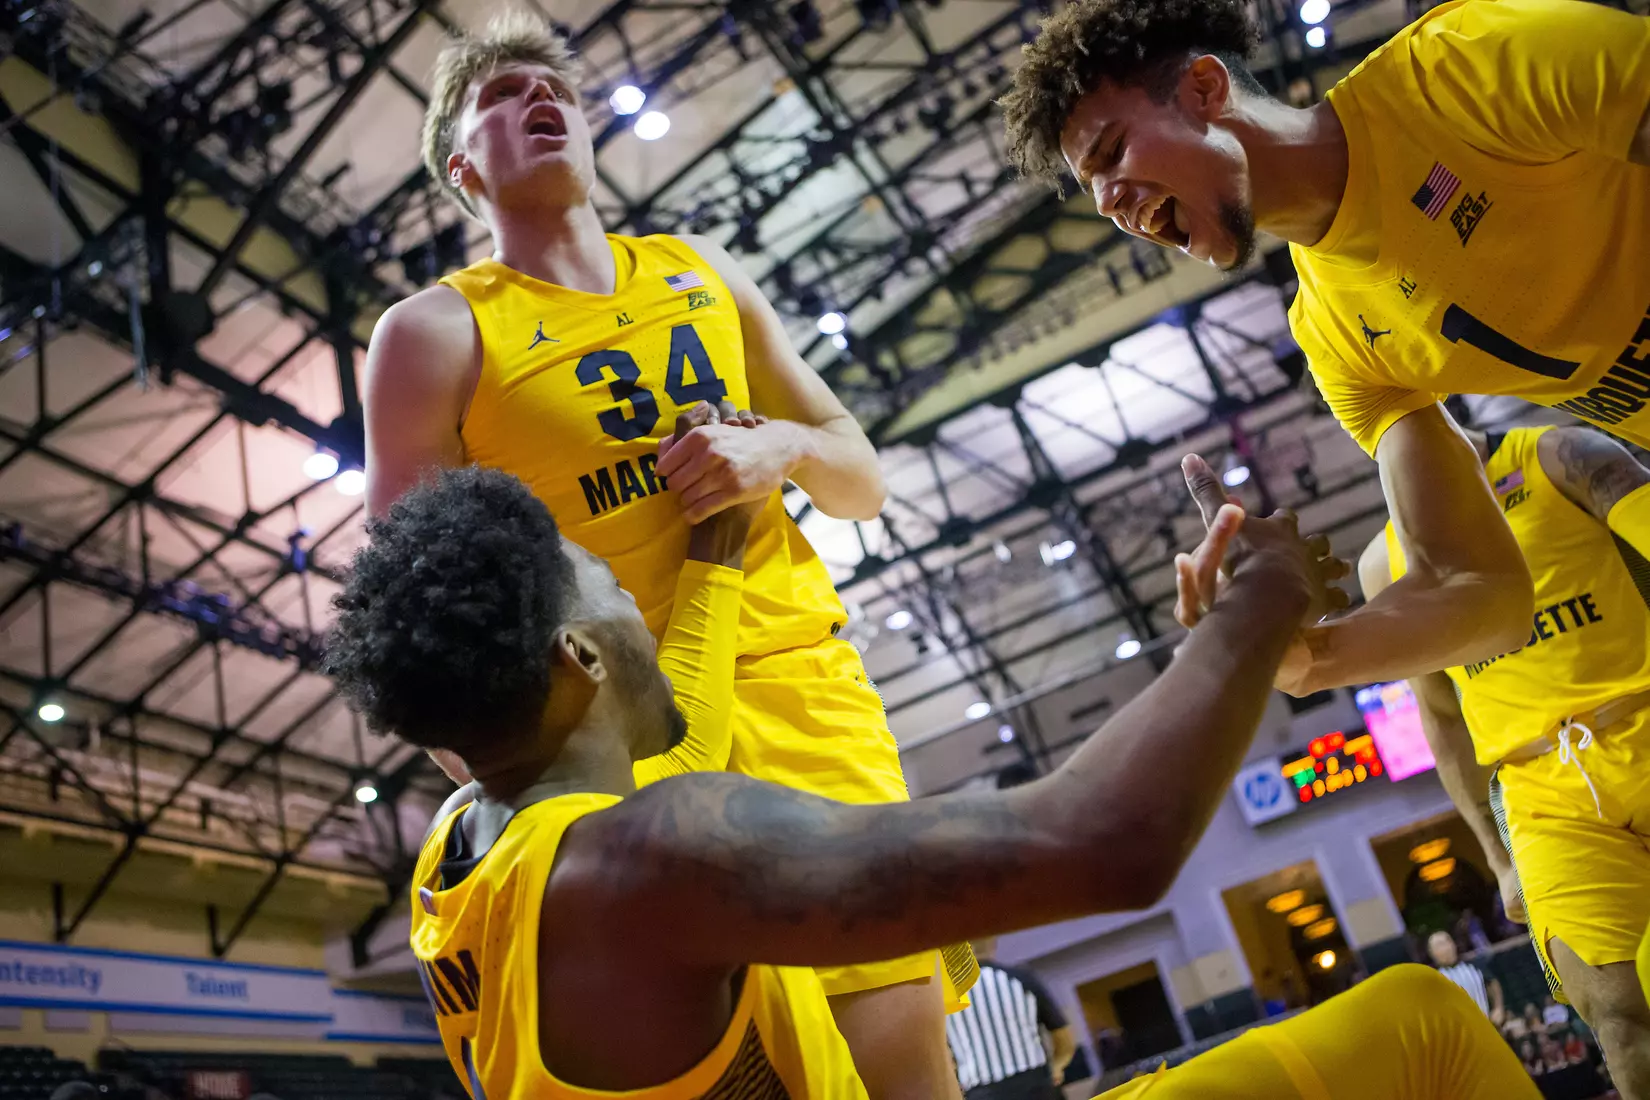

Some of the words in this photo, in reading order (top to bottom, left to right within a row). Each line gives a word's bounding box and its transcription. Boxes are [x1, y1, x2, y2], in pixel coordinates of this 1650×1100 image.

[1450, 192, 1473, 228] BIG
[1457, 191, 1488, 240] EAST
[688, 290, 708, 301] BIG
[1399, 277, 1417, 299] AL
[616, 312, 634, 327] AL
[1440, 303, 1581, 380] 1
[575, 323, 728, 442] 34
[578, 452, 669, 516] MAR
